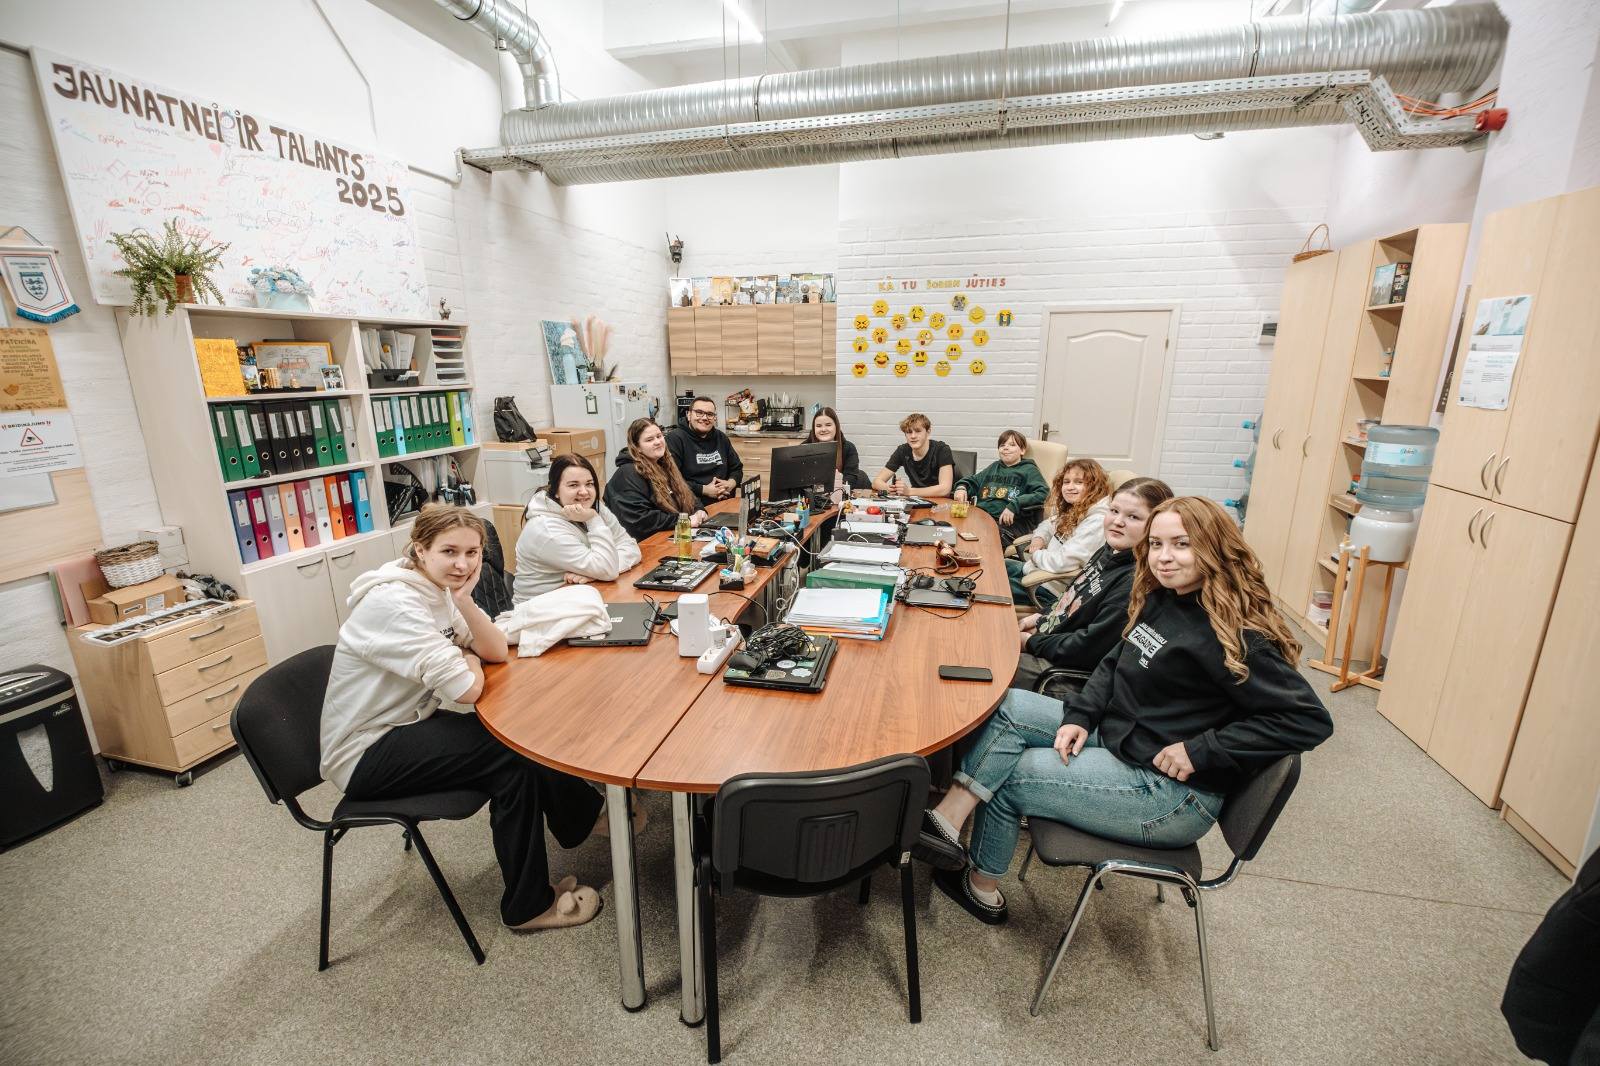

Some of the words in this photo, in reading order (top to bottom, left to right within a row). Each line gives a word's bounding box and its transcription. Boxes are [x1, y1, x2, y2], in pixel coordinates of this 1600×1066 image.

[270, 126, 366, 182] TALANTS
[335, 177, 405, 217] 2025
[902, 281, 917, 290] TU
[966, 273, 1006, 288] JŪTIES
